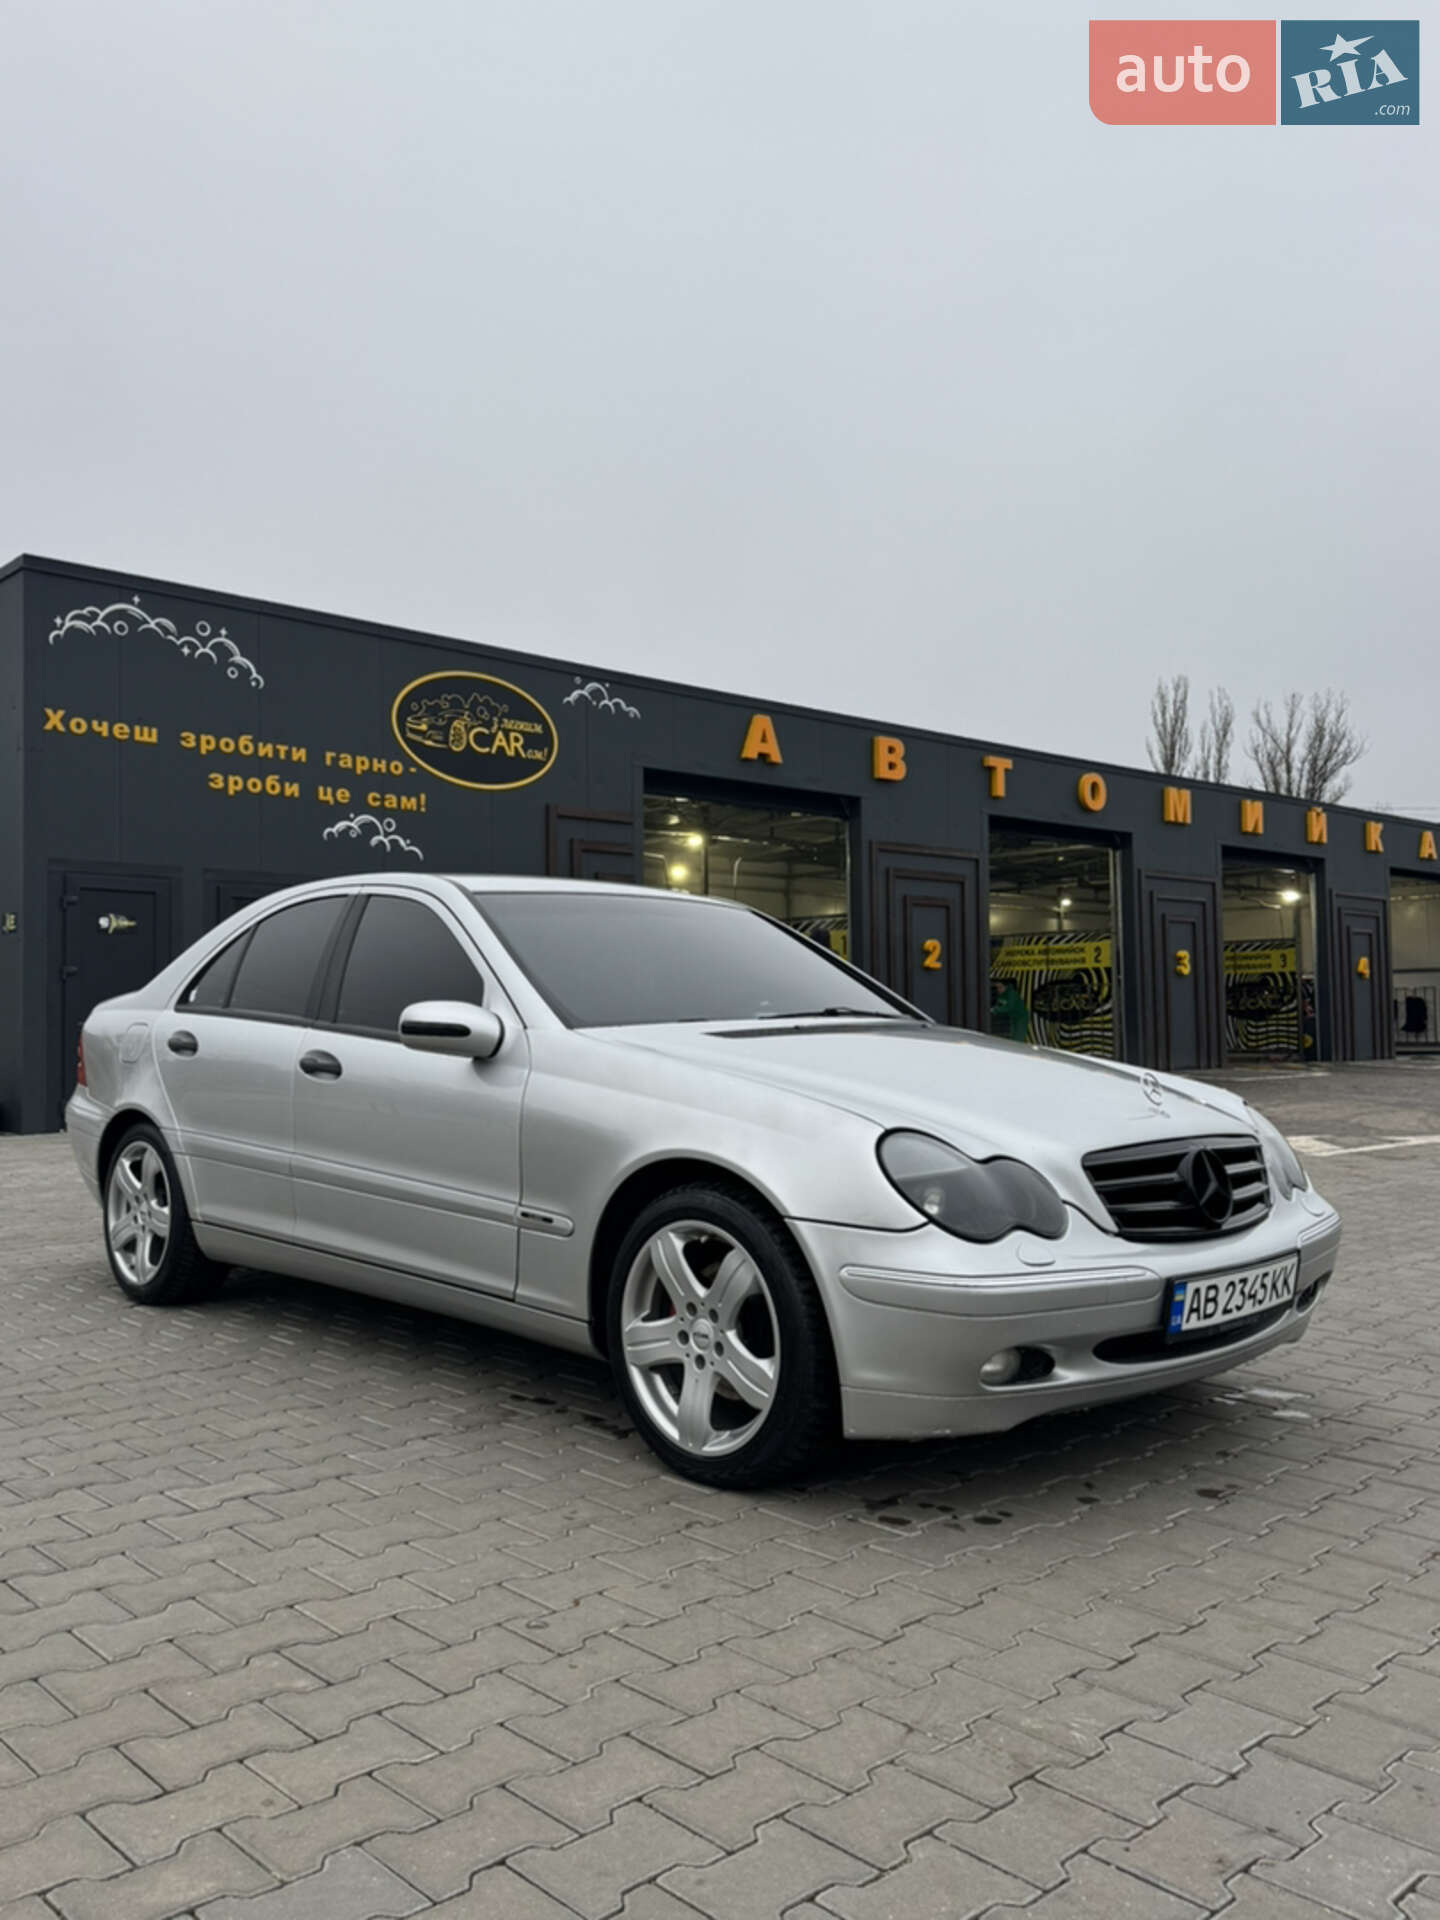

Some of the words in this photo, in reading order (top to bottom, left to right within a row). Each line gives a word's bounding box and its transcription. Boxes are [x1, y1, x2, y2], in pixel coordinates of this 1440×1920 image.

[43, 707, 159, 744] Хочеш
[179, 730, 307, 763] зробити
[468, 727, 526, 759] CAR
[208, 771, 301, 799] зроби
[317, 785, 352, 806] це
[366, 791, 428, 813] сам!
[740, 713, 1439, 862] АВТОМИЙКА
[922, 938, 943, 970] 2
[1093, 945, 1102, 963] 2
[1175, 950, 1191, 976] 3
[1280, 953, 1287, 968] 3
[1356, 956, 1370, 979] 4
[1185, 1283, 1219, 1323] AB
[1221, 1272, 1269, 1315] 2345
